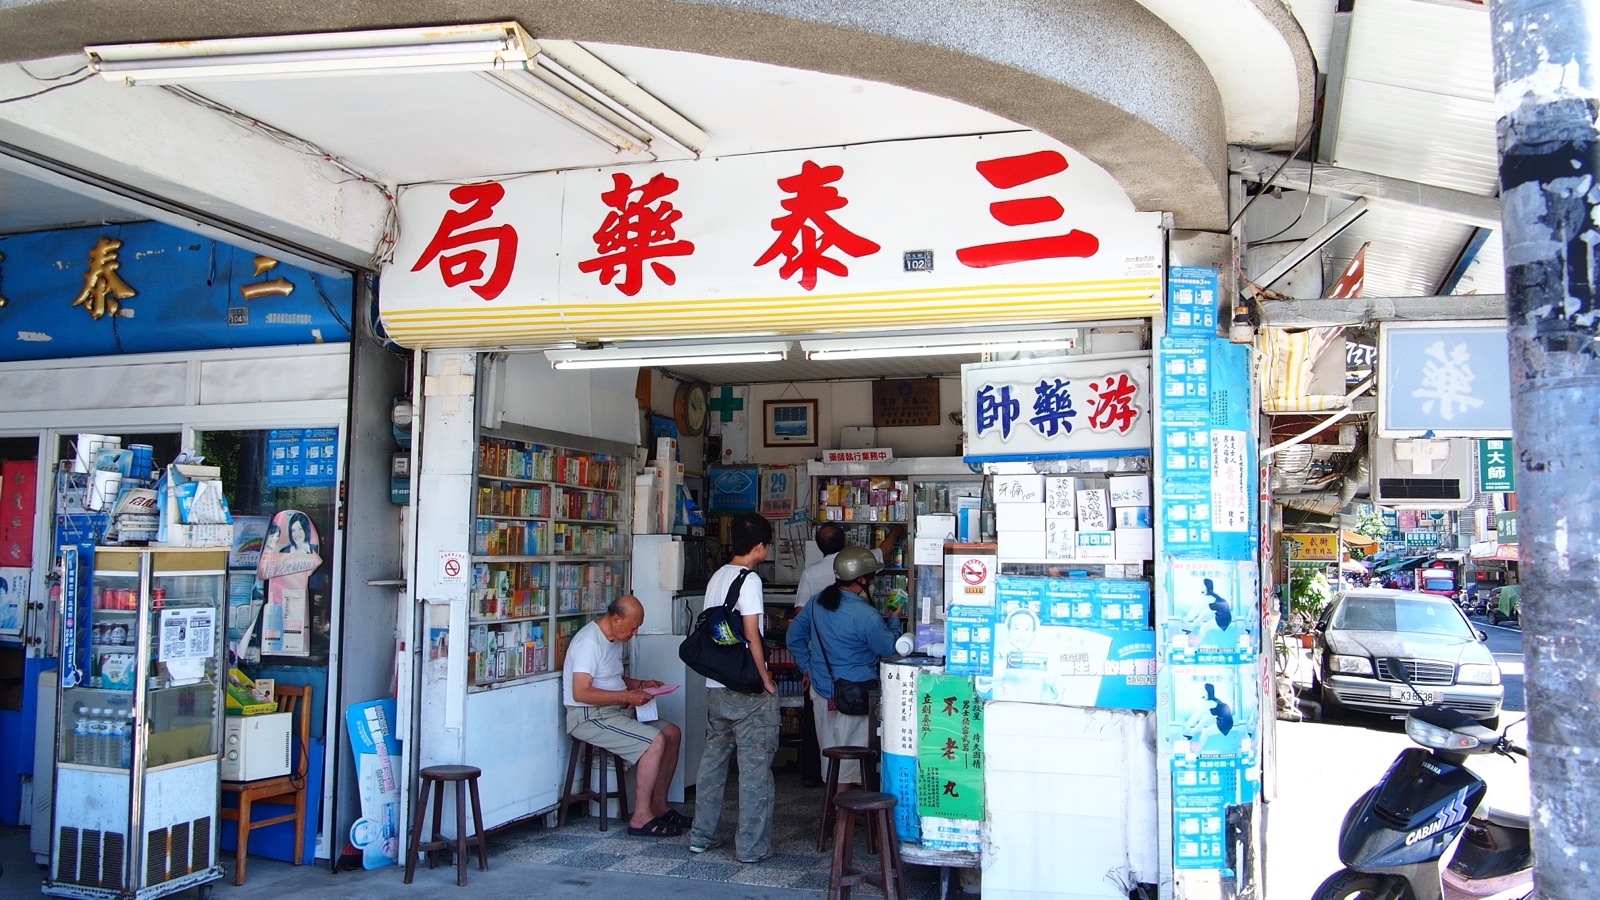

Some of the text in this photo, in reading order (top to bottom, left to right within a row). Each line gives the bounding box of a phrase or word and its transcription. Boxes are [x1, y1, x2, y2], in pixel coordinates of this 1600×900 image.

[907, 259, 925, 270] 102
[976, 374, 1138, 440] 游藥師
[828, 452, 887, 462] 藥師執行業務中
[770, 472, 788, 493] 29
[941, 696, 960, 798] 不老丸
[1421, 761, 1442, 775] YAMAHA
[1405, 816, 1442, 846] CABIN
